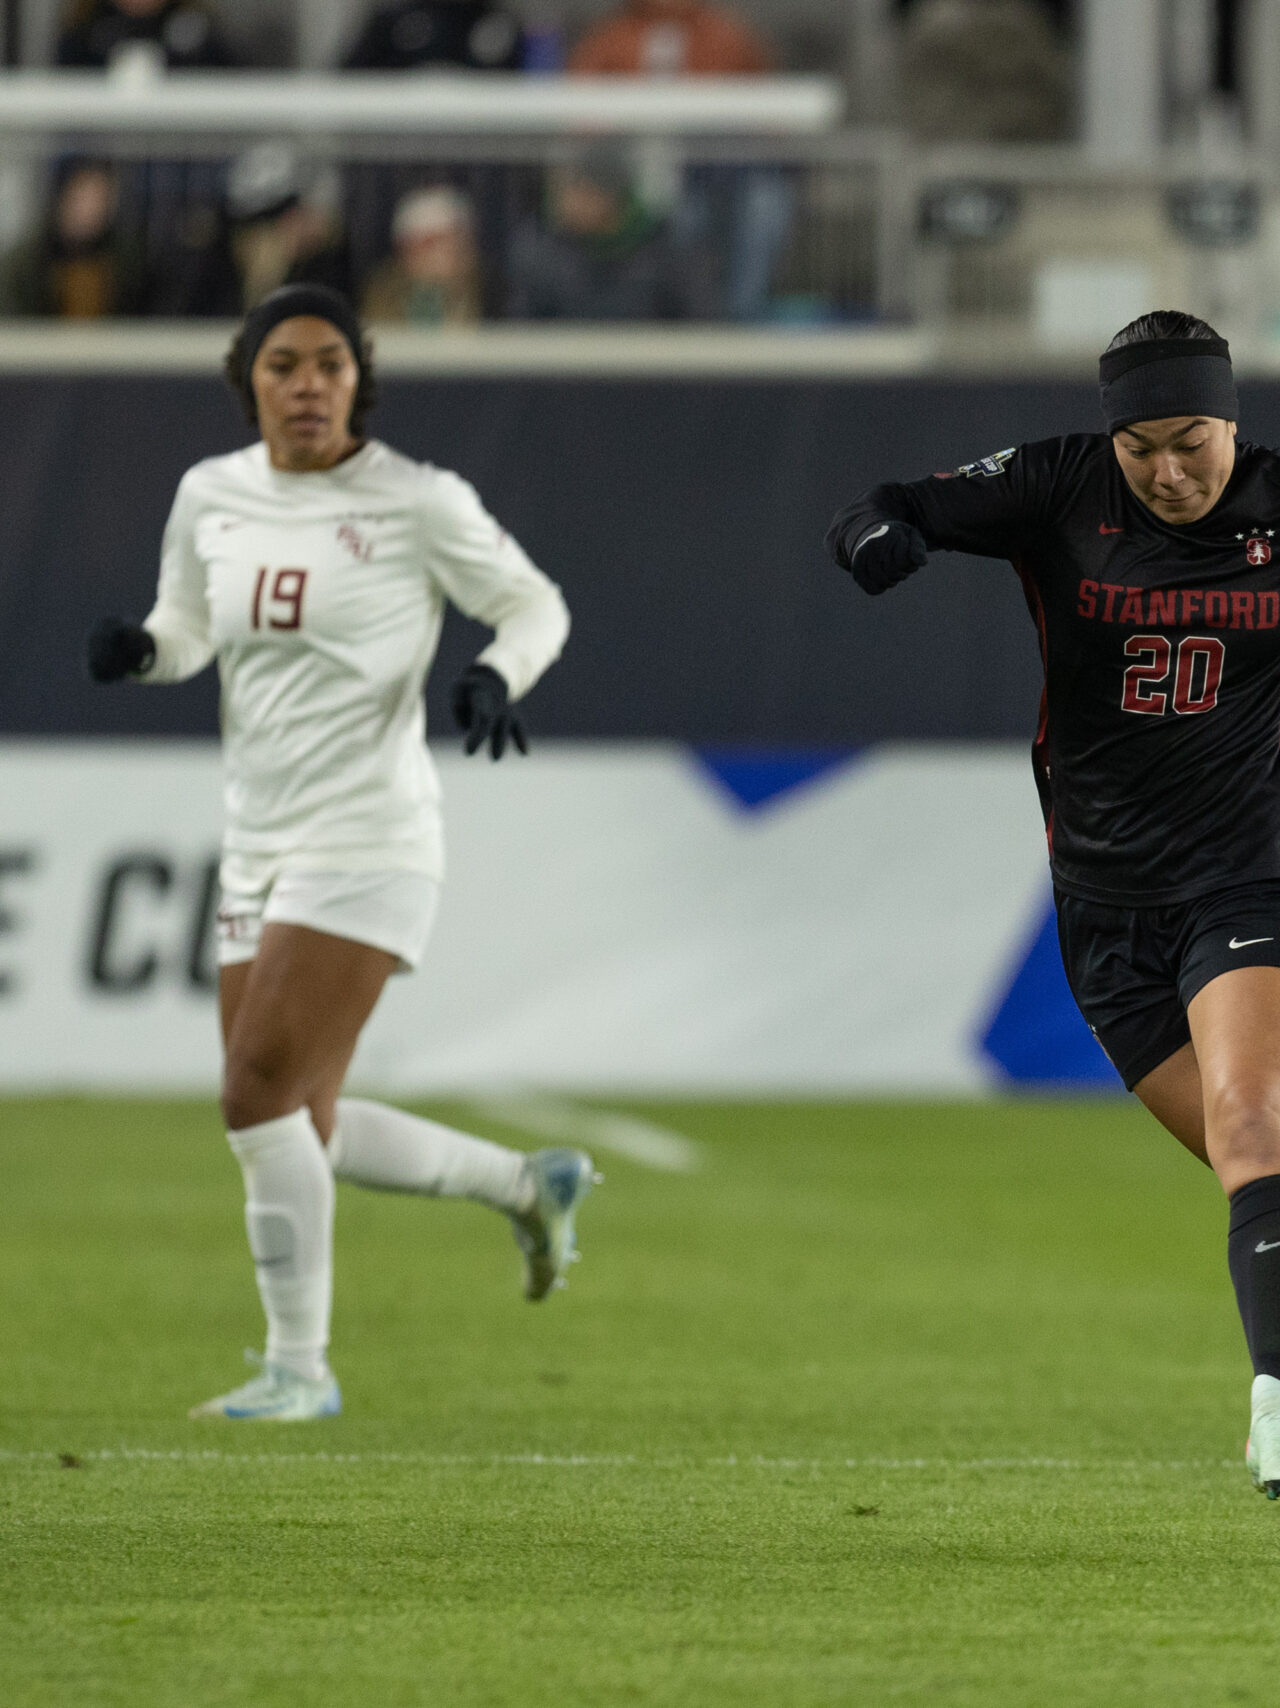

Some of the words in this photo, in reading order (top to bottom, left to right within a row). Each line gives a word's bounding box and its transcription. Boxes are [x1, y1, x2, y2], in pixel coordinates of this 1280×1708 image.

[253, 567, 307, 631] 19
[1077, 578, 1280, 630] STANFORD
[1121, 635, 1226, 715] 20
